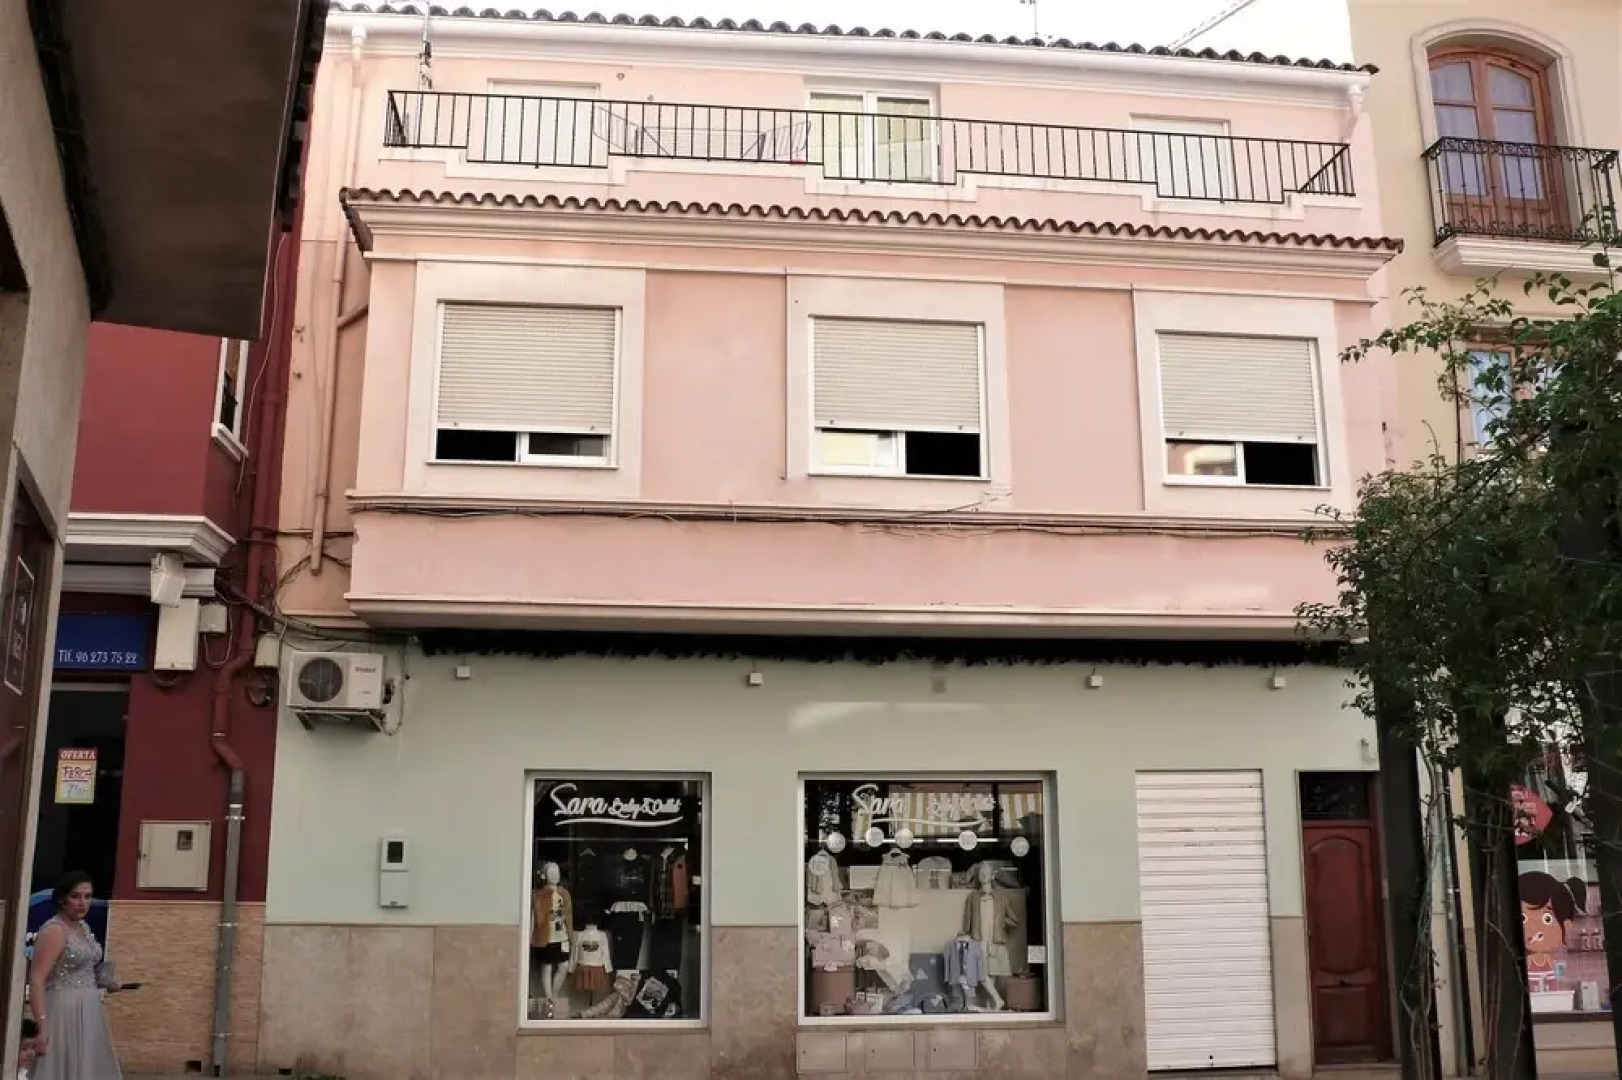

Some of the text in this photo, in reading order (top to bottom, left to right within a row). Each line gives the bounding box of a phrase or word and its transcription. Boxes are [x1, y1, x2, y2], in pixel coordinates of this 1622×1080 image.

[76, 651, 88, 663] 96
[90, 651, 108, 663] 273
[111, 651, 123, 664] 75
[125, 651, 137, 664] 22
[61, 750, 95, 760] OFERTA
[550, 783, 608, 816] Sara
[608, 798, 640, 819] Baby
[853, 783, 906, 814] Sara
